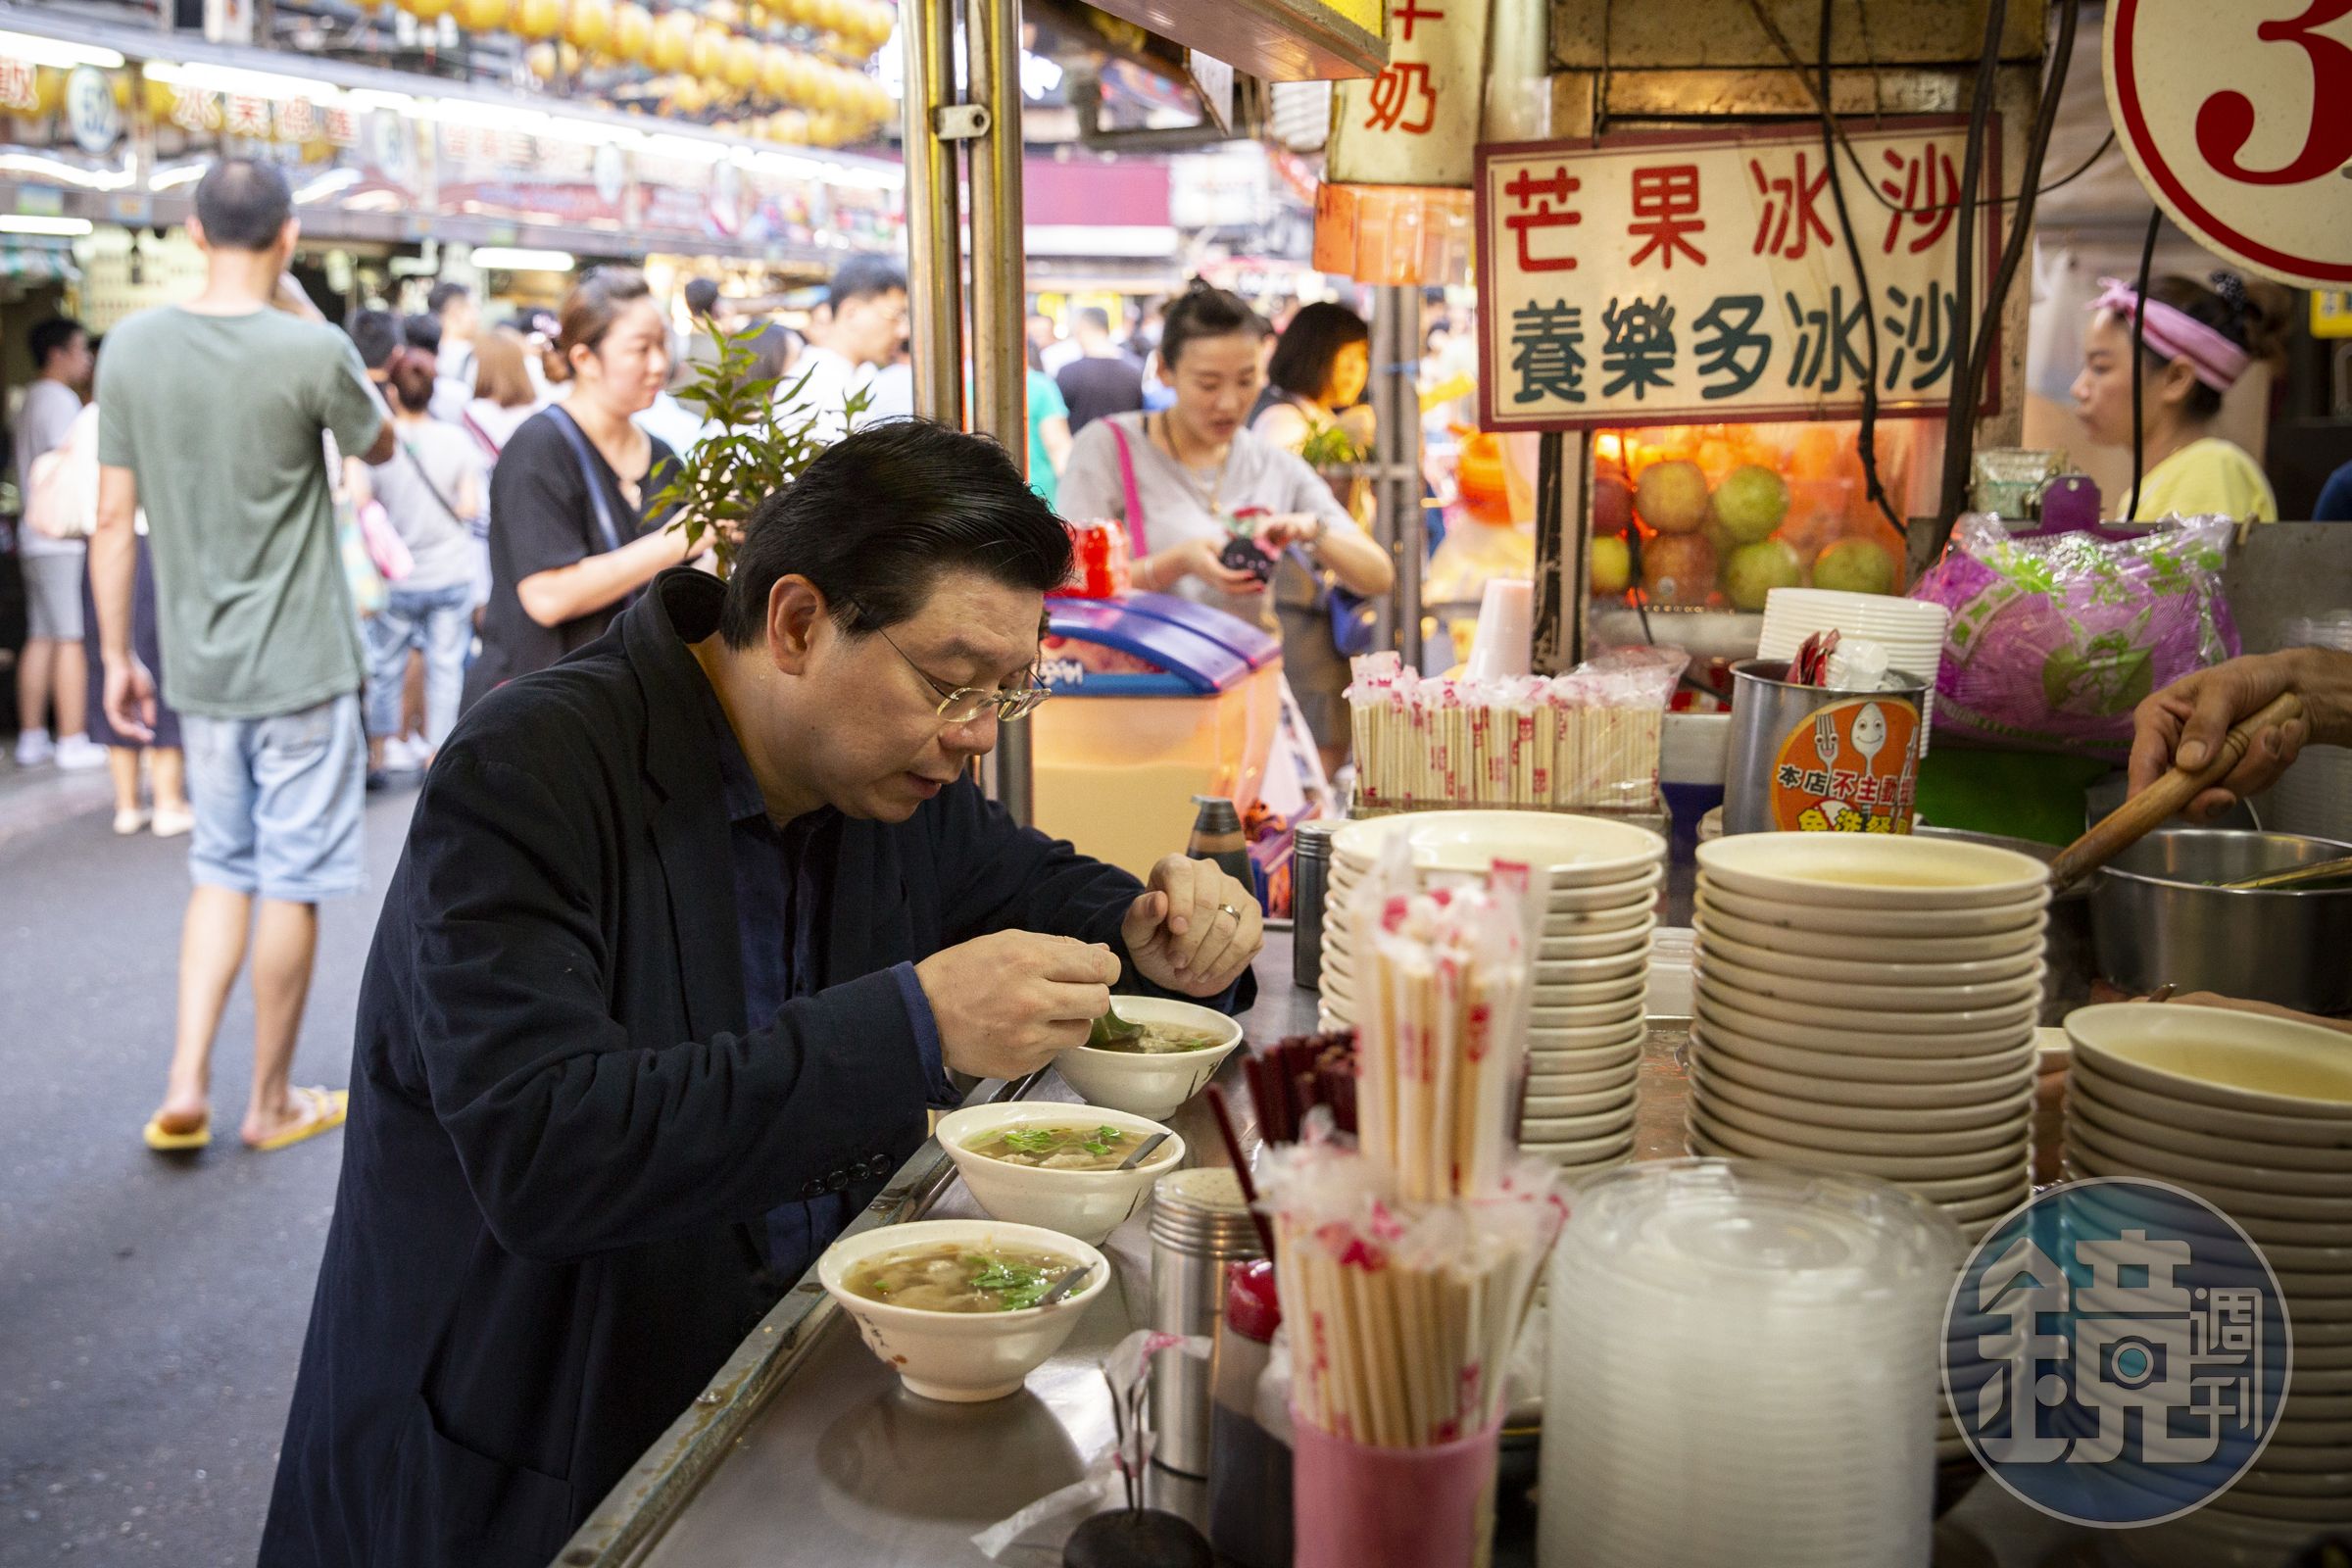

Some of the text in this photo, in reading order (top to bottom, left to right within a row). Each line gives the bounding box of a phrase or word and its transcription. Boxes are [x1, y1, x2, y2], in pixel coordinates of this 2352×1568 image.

[2195, 0, 2352, 186] 3
[1504, 142, 1962, 272] 芒果冰沙
[1511, 280, 1957, 405] 養樂多冰沙
